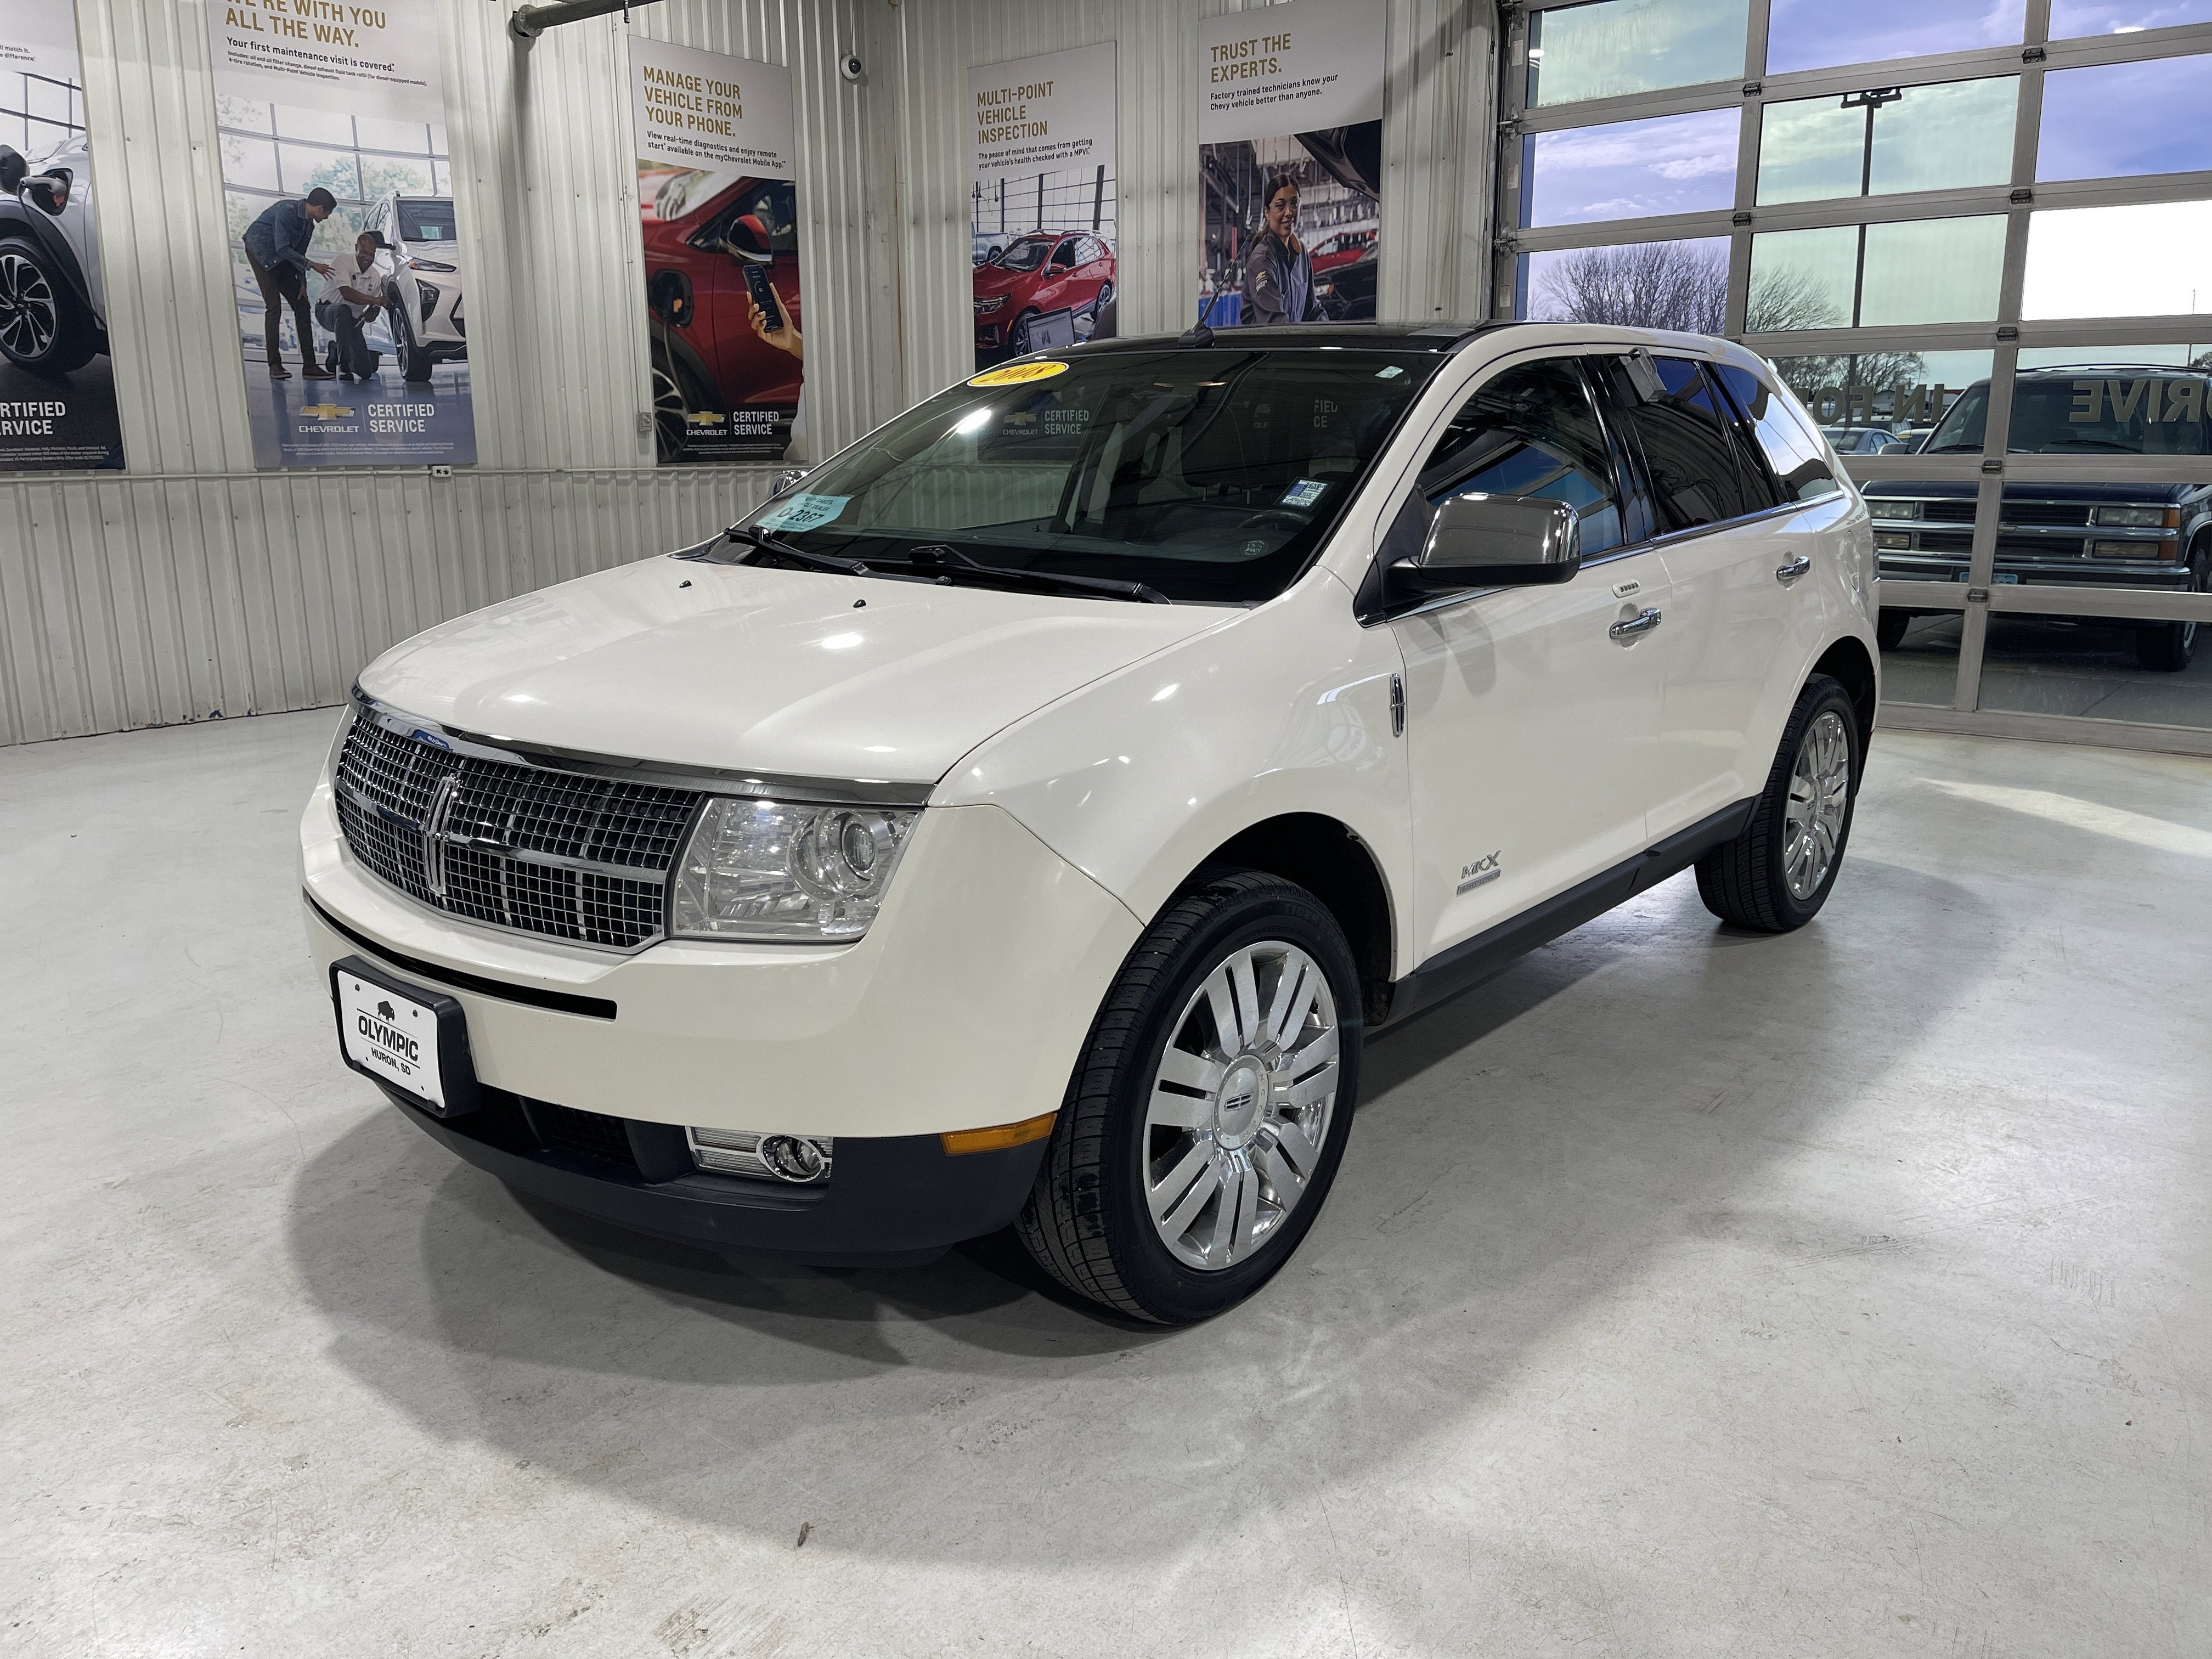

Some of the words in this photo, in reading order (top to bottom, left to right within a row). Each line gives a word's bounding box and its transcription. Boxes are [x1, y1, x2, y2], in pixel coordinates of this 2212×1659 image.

[225, 8, 264, 32] ALL
[269, 15, 308, 40] THE
[313, 23, 359, 48] WAY.
[294, 0, 344, 22] WITH
[348, 5, 386, 30] YOU
[227, 36, 247, 48] Your
[250, 41, 270, 53] first
[273, 47, 329, 63] maintenance
[330, 55, 348, 65] visit
[350, 57, 358, 67] is
[1210, 39, 1257, 63] TRUST
[1262, 33, 1291, 54] THE
[643, 66, 702, 93] MANAGE
[706, 78, 741, 100] YOUR
[1211, 57, 1282, 83] EXPERTS.
[977, 81, 1054, 107] MULTI-POINT
[1210, 91, 1235, 100] Factory
[1237, 86, 1260, 97] trained
[1262, 81, 1300, 93] technicians
[1302, 78, 1321, 87] know
[1322, 74, 1339, 85] your
[1210, 102, 1230, 111] Chevy
[1232, 98, 1254, 109] vehicle
[1256, 95, 1277, 105] better
[1278, 92, 1294, 101] than
[1295, 88, 1322, 99] anyone.
[644, 86, 703, 112] VEHICLE
[707, 99, 742, 119] FROM
[978, 105, 1026, 126] VEHICLE
[645, 105, 684, 128] YOUR
[687, 114, 736, 137] PHONE.
[978, 120, 1048, 144] INSPECTION
[647, 130, 662, 140] View
[664, 134, 692, 146] real-time
[693, 139, 727, 151] diagnostics
[741, 148, 756, 157] enjoy
[667, 145, 693, 156] available
[703, 151, 714, 159] the
[715, 154, 751, 165] myChevrolet
[752, 158, 770, 167] Mobile
[989, 151, 1004, 160] peace
[1012, 146, 1025, 155] mind
[1026, 145, 1037, 154] that
[1038, 144, 1056, 152] comes
[1057, 141, 1070, 149] from
[1072, 138, 1092, 149] getting
[978, 162, 990, 171] your
[991, 158, 1013, 167] vehicle's
[1014, 155, 1031, 165] health
[1032, 151, 1054, 162] checked
[1056, 150, 1068, 160] with
[368, 404, 435, 417] CERTIFIED
[733, 411, 779, 422] CERTIFIED
[1045, 410, 1089, 422] CERTIFIED
[0, 420, 53, 436] RVICE
[370, 419, 426, 433] SERVICE
[734, 424, 772, 435] SERVICE
[1045, 424, 1082, 435] SERVICE
[1461, 850, 1502, 879] MKX
[358, 1015, 419, 1063] OLYMPIC
[371, 1047, 399, 1072] HURON,
[400, 1062, 411, 1076] SD
